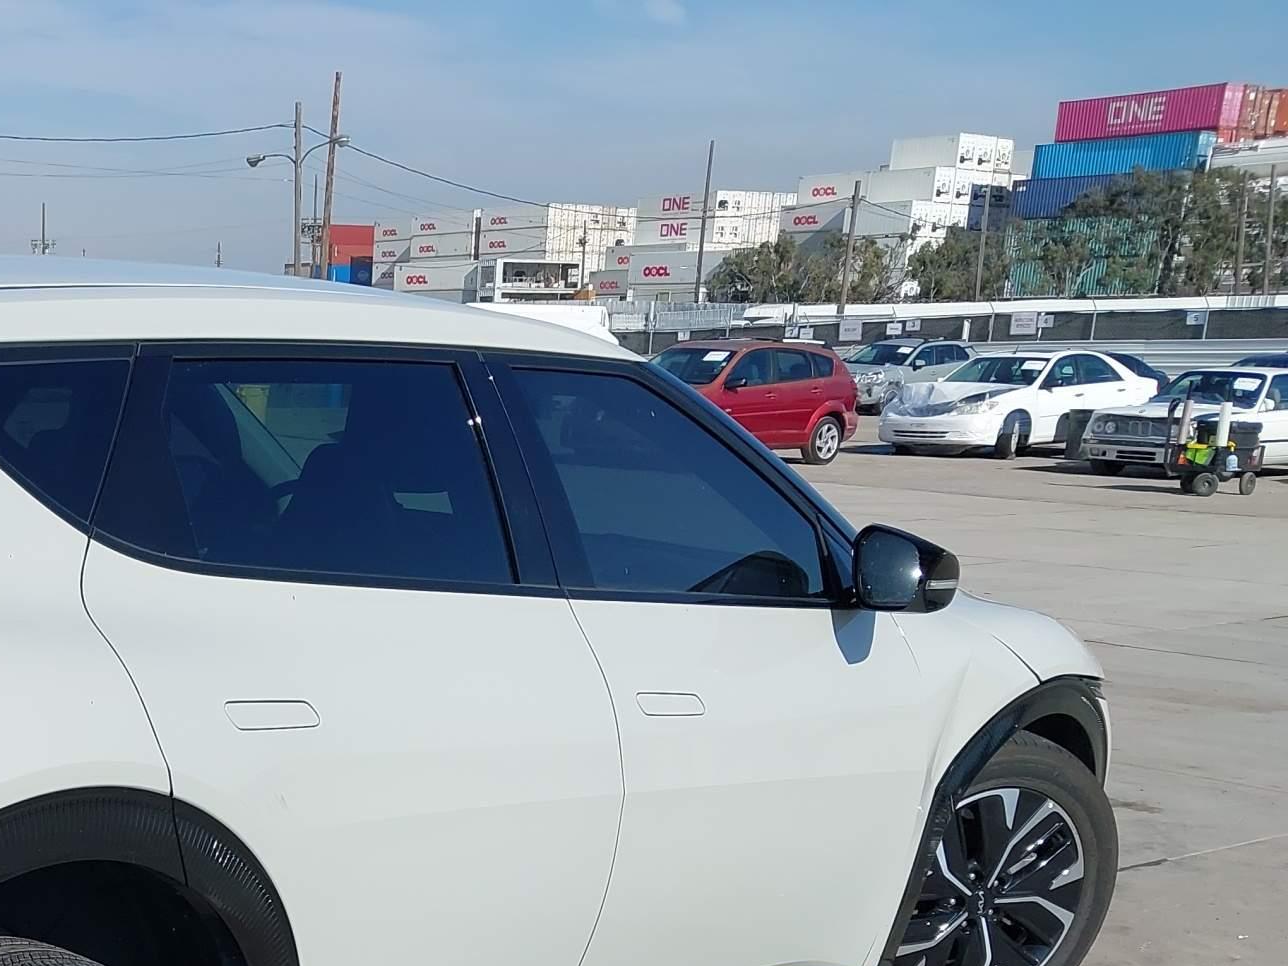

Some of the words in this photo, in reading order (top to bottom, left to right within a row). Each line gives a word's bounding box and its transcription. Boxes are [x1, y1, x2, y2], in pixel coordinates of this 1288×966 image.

[1107, 96, 1166, 124] ONE
[812, 187, 837, 197] OOCL
[662, 196, 691, 212] ONE
[490, 217, 508, 225] OOCL
[793, 215, 819, 226] OOCL
[420, 223, 436, 231] OOCL
[659, 223, 688, 237] ONE
[489, 240, 507, 249] OOCL
[617, 256, 629, 265] OO
[380, 271, 394, 279] OOC
[643, 266, 670, 278] OOCL
[406, 275, 428, 285] OOCL
[600, 281, 620, 289] OOCL
[1193, 314, 1200, 322] 5
